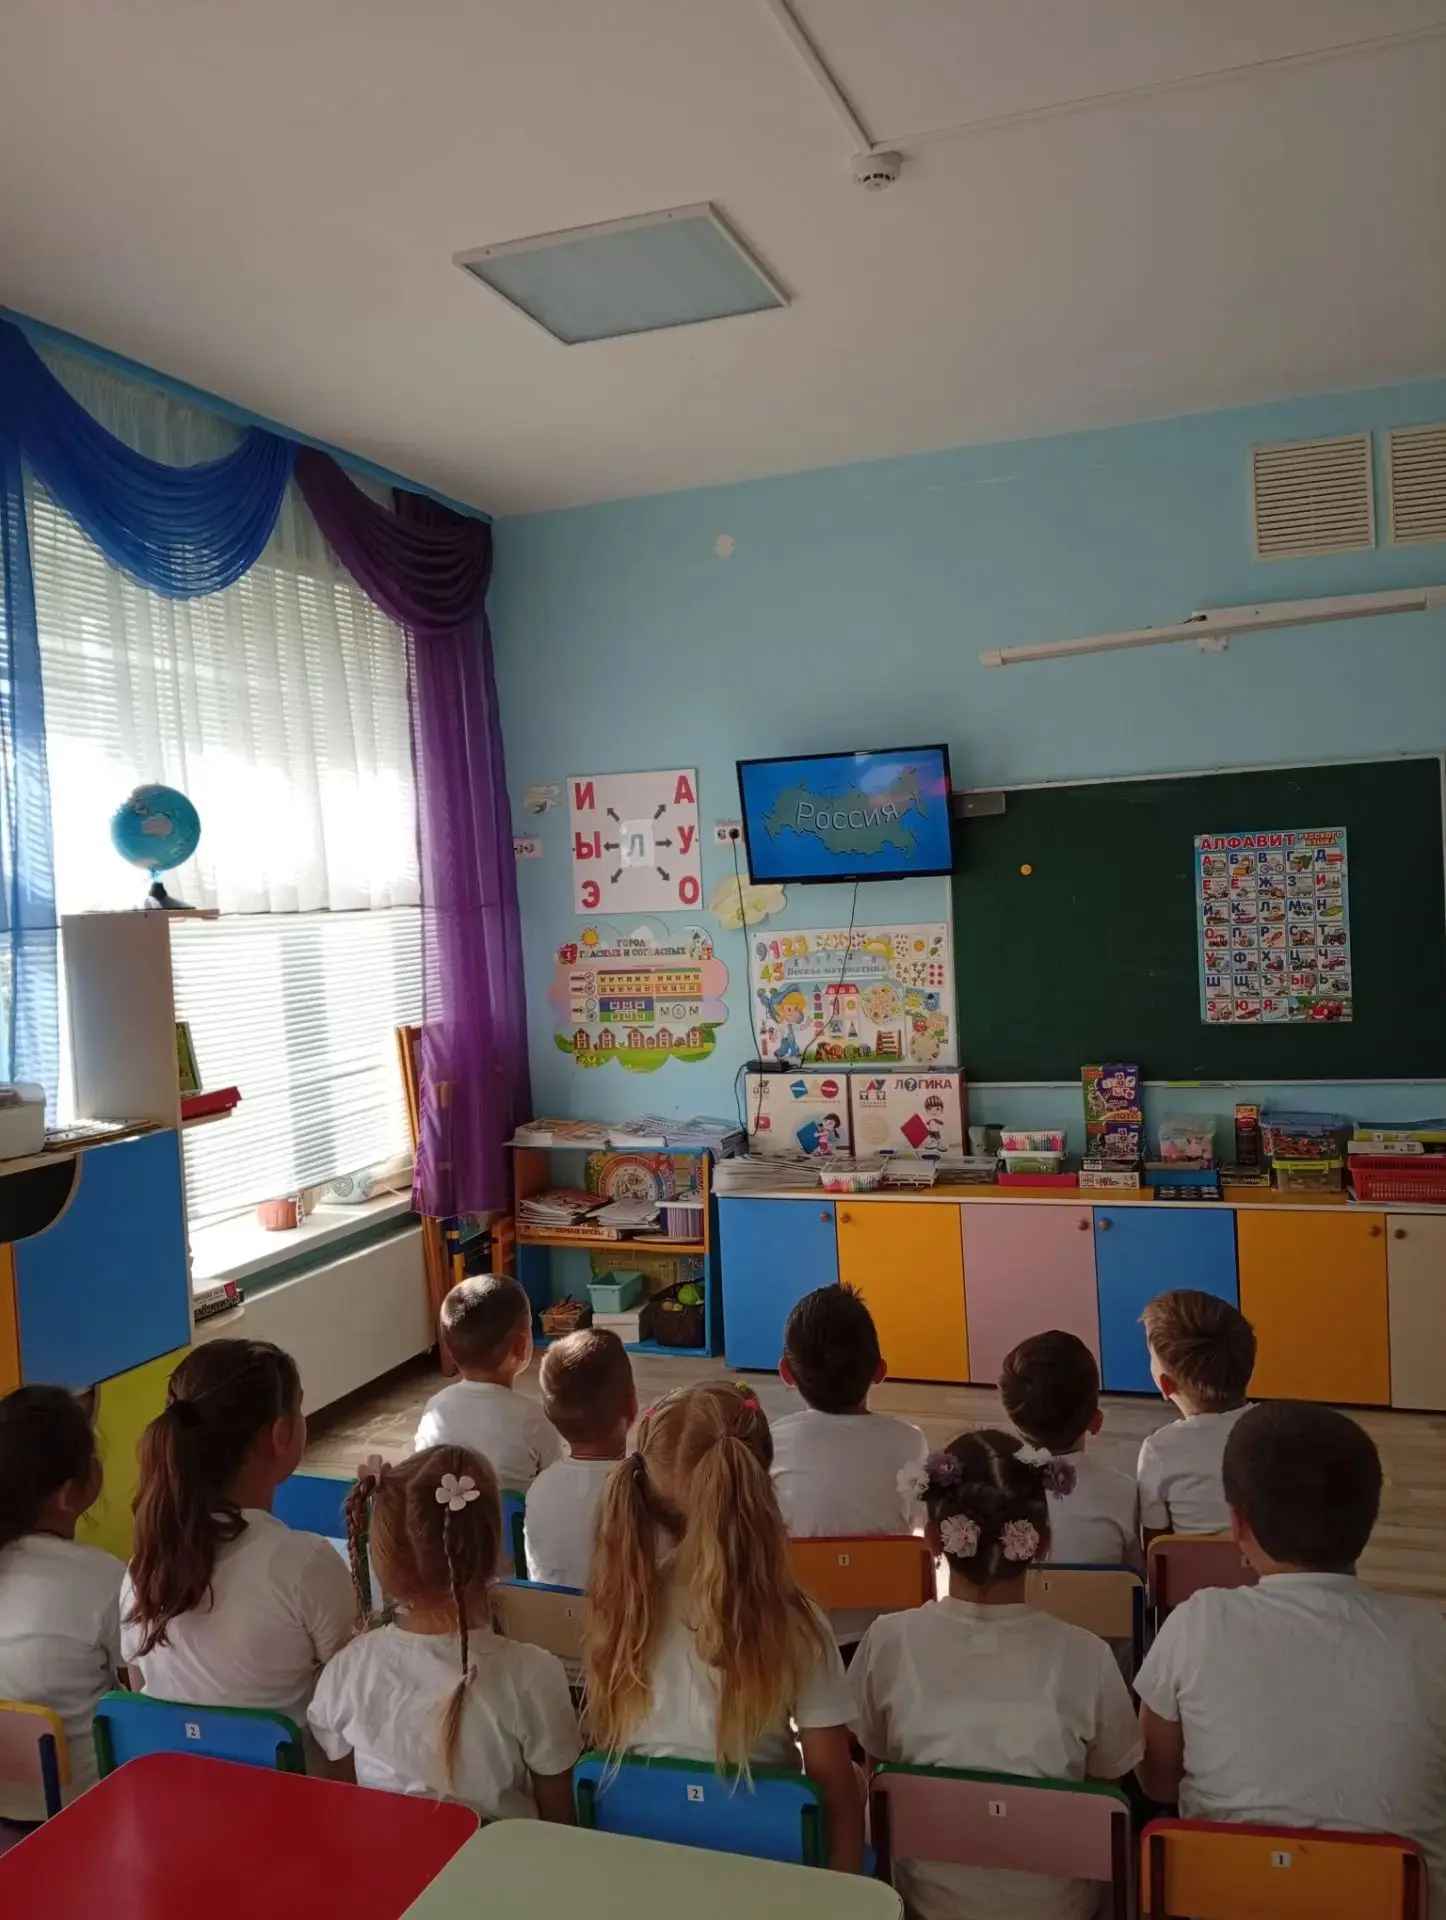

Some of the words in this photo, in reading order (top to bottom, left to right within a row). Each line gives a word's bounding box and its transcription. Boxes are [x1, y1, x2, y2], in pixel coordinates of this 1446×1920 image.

[574, 781, 595, 811] И
[673, 775, 695, 804] А
[795, 801, 900, 831] Россия
[677, 825, 695, 855] У
[1200, 833, 1295, 850] АЛФАВИТ
[1298, 831, 1343, 840] РУССКОГО
[575, 831, 602, 860] Ы
[626, 833, 645, 857] Л
[1202, 855, 1212, 866] А
[1229, 854, 1239, 865] Б
[1258, 853, 1268, 863] В
[1286, 851, 1295, 861] Г
[1315, 849, 1327, 862] Д
[678, 875, 700, 905] О
[1202, 879, 1212, 890] Е
[1230, 876, 1240, 889] Ё
[1259, 877, 1271, 888] Ж
[1287, 876, 1297, 886] З
[1316, 874, 1326, 885] И
[581, 880, 601, 909] Э
[1203, 903, 1213, 916] Й
[1231, 903, 1241, 914] К
[1259, 901, 1270, 912] Л
[1288, 900, 1302, 911] М
[1316, 899, 1327, 910] Н
[1205, 928, 1214, 939] О
[1232, 927, 1242, 938] П
[1261, 926, 1270, 937] Р
[1289, 925, 1298, 936] С
[1318, 924, 1328, 934] Т
[579, 949, 621, 958] ГАСНЫХ
[624, 949, 630, 957] И
[632, 946, 687, 957] СОГАСНЫХ
[617, 939, 646, 948] ГОРОД
[1205, 952, 1215, 963] У
[1233, 951, 1246, 964] Ф
[1261, 951, 1271, 962] Х
[1290, 950, 1301, 962] Ц
[1318, 949, 1328, 959] Ч
[1206, 976, 1220, 986] Ш
[1234, 975, 1249, 988] Щ
[1263, 975, 1273, 985] Ъ
[1291, 974, 1304, 984] Ы
[1319, 974, 1328, 984] Ь
[1207, 1001, 1216, 1011] Э
[1235, 1000, 1248, 1010] Ю
[1263, 999, 1273, 1009] Я
[189, 1726, 198, 1737] 2
[691, 1788, 700, 1800] 2
